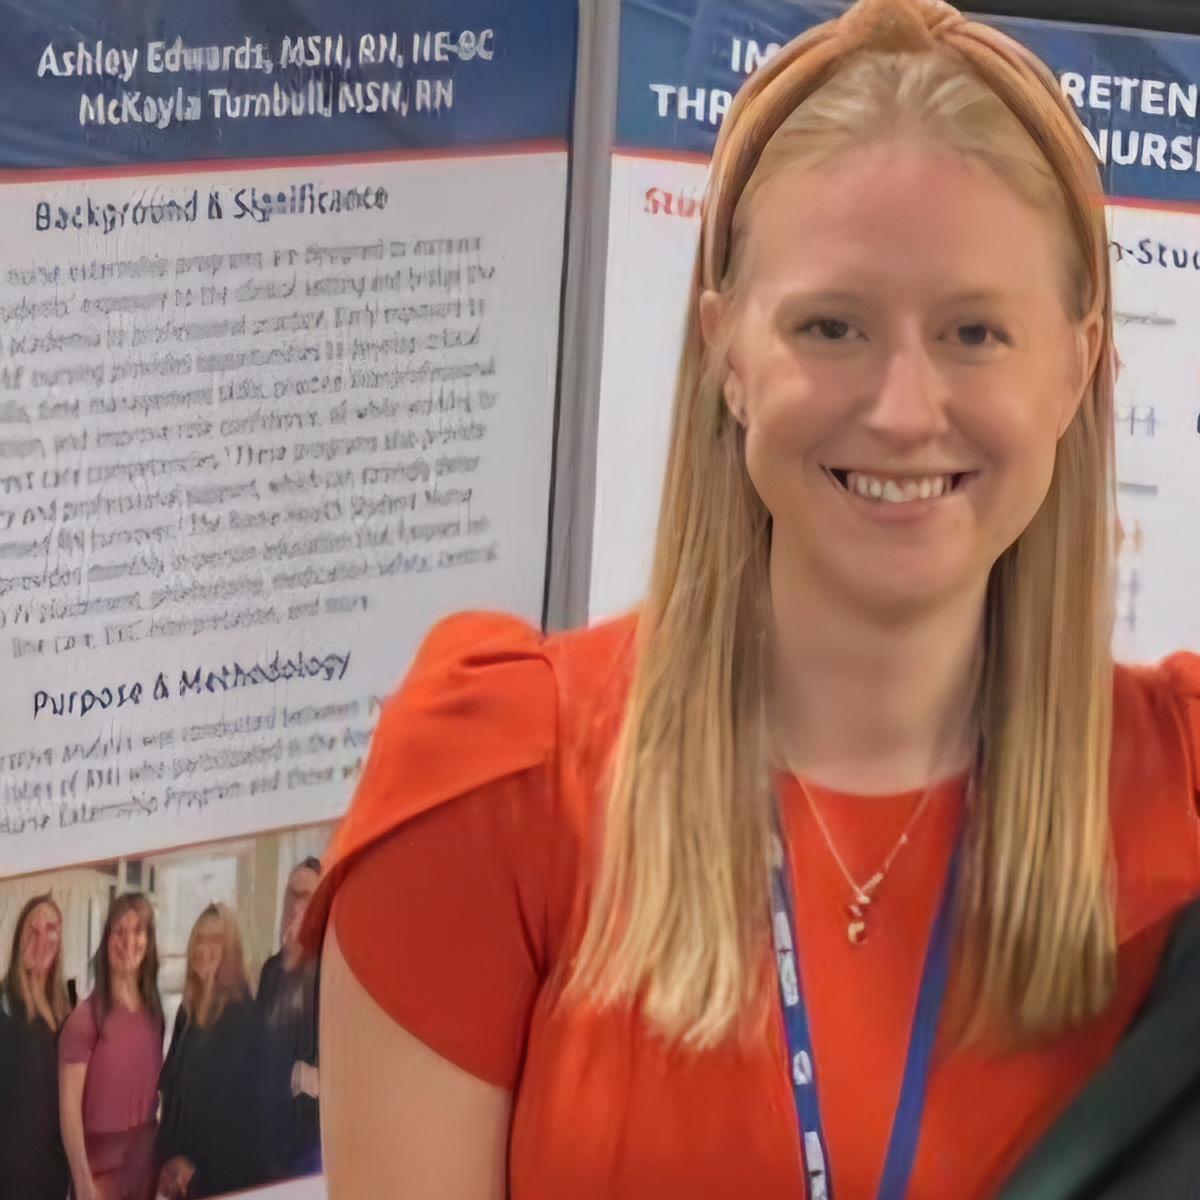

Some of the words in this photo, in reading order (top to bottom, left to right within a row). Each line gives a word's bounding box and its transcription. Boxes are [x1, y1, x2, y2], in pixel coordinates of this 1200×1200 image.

[37, 40, 138, 82] Ashley
[415, 78, 453, 117] RN
[35, 188, 198, 235] Background
[34, 681, 142, 719] Purpose
